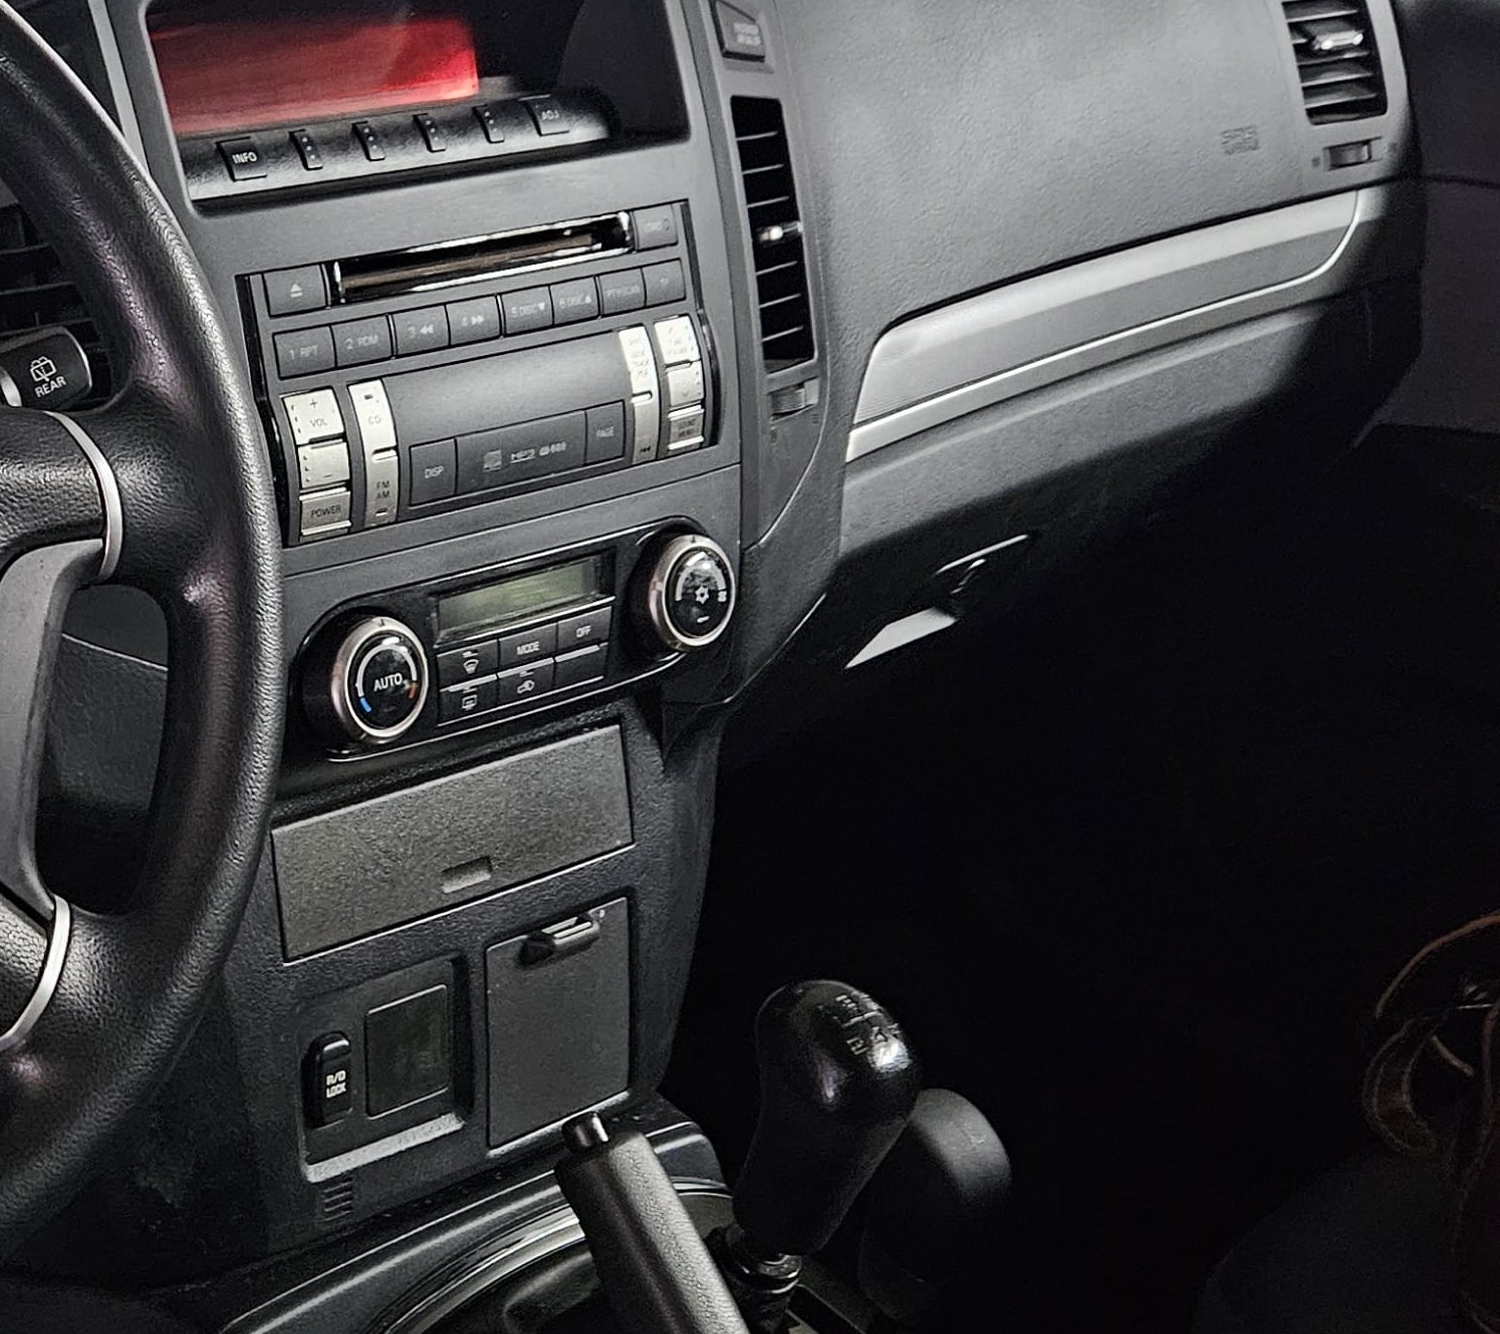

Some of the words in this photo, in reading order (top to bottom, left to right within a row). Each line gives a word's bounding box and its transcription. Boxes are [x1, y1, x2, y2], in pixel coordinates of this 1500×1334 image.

[231, 151, 258, 164] INFO
[34, 376, 67, 398] REAR
[310, 504, 342, 518] POWER
[575, 625, 592, 638] OFF
[515, 641, 541, 655] MODE
[373, 672, 403, 692] AUTO
[326, 1082, 347, 1099] LOCK
